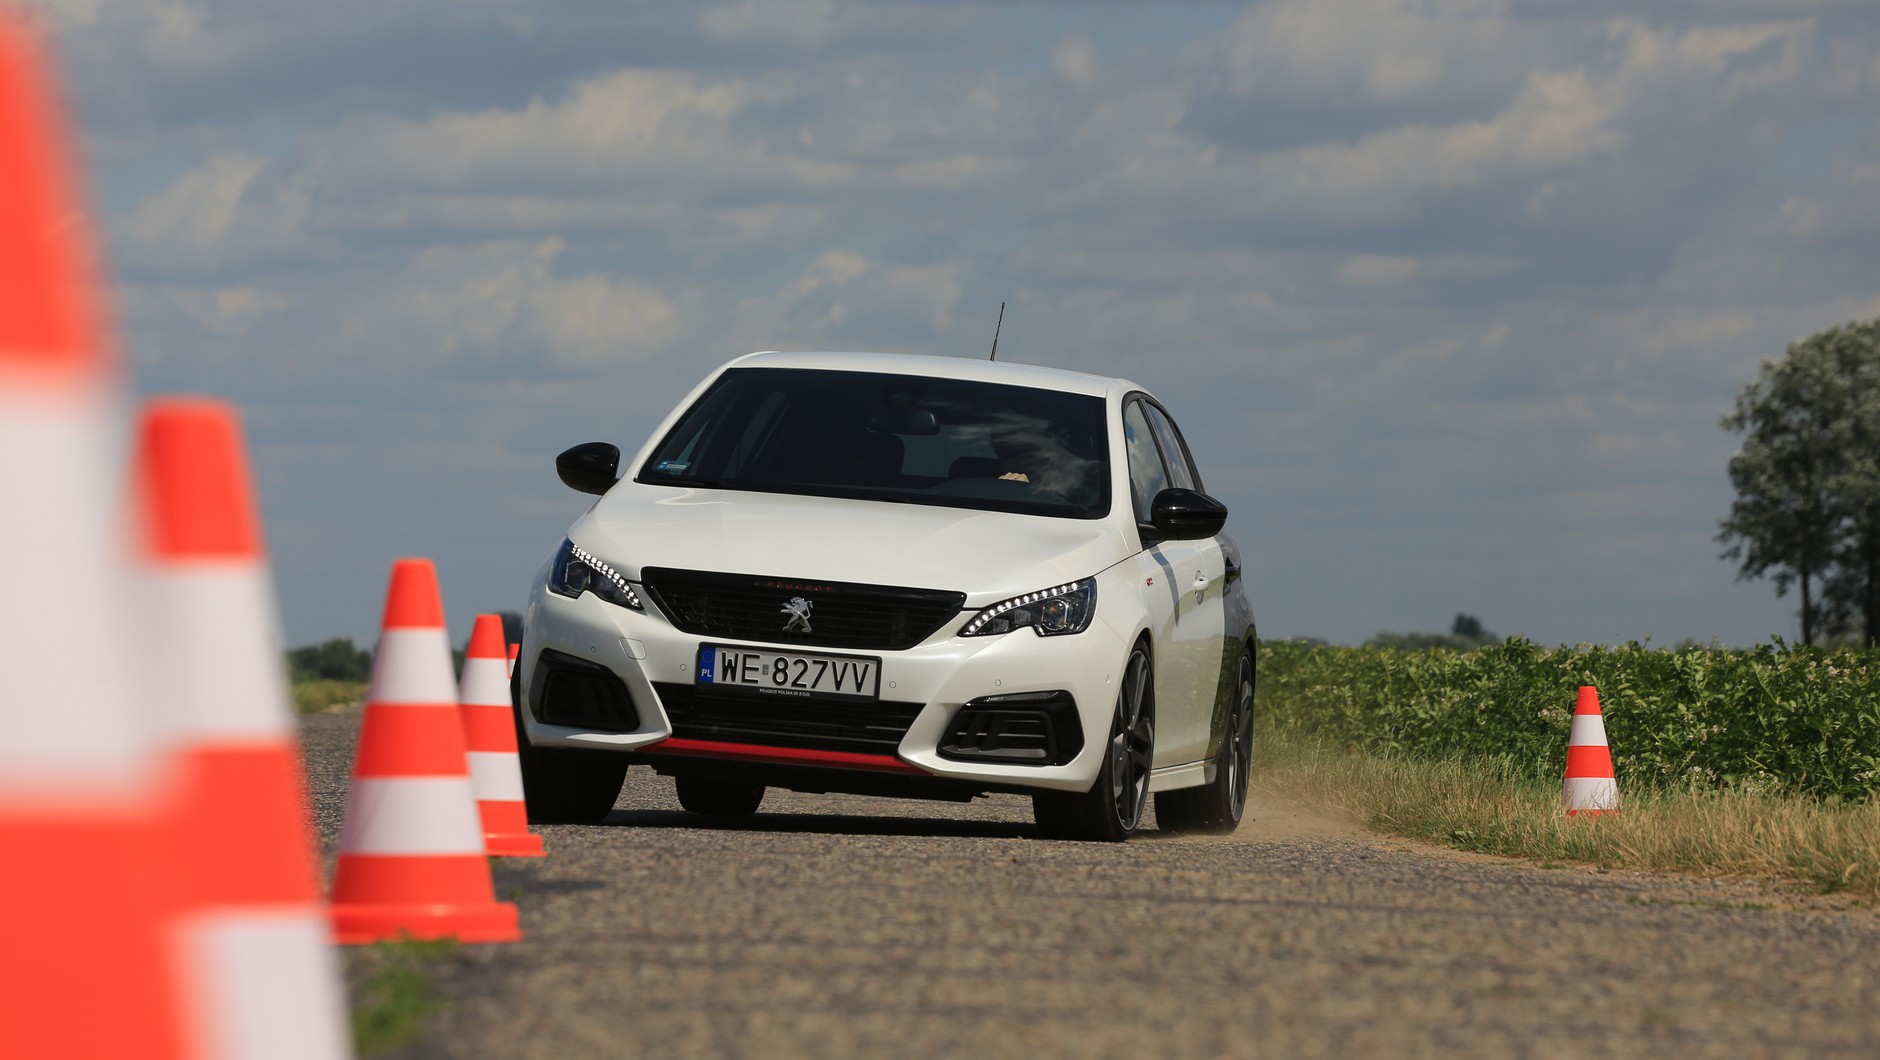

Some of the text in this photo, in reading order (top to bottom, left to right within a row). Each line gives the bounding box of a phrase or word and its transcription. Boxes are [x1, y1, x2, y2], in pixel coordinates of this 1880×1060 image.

[767, 581, 832, 592] PEUGEOT
[701, 669, 712, 678] PL
[721, 652, 869, 693] WE 827VV
